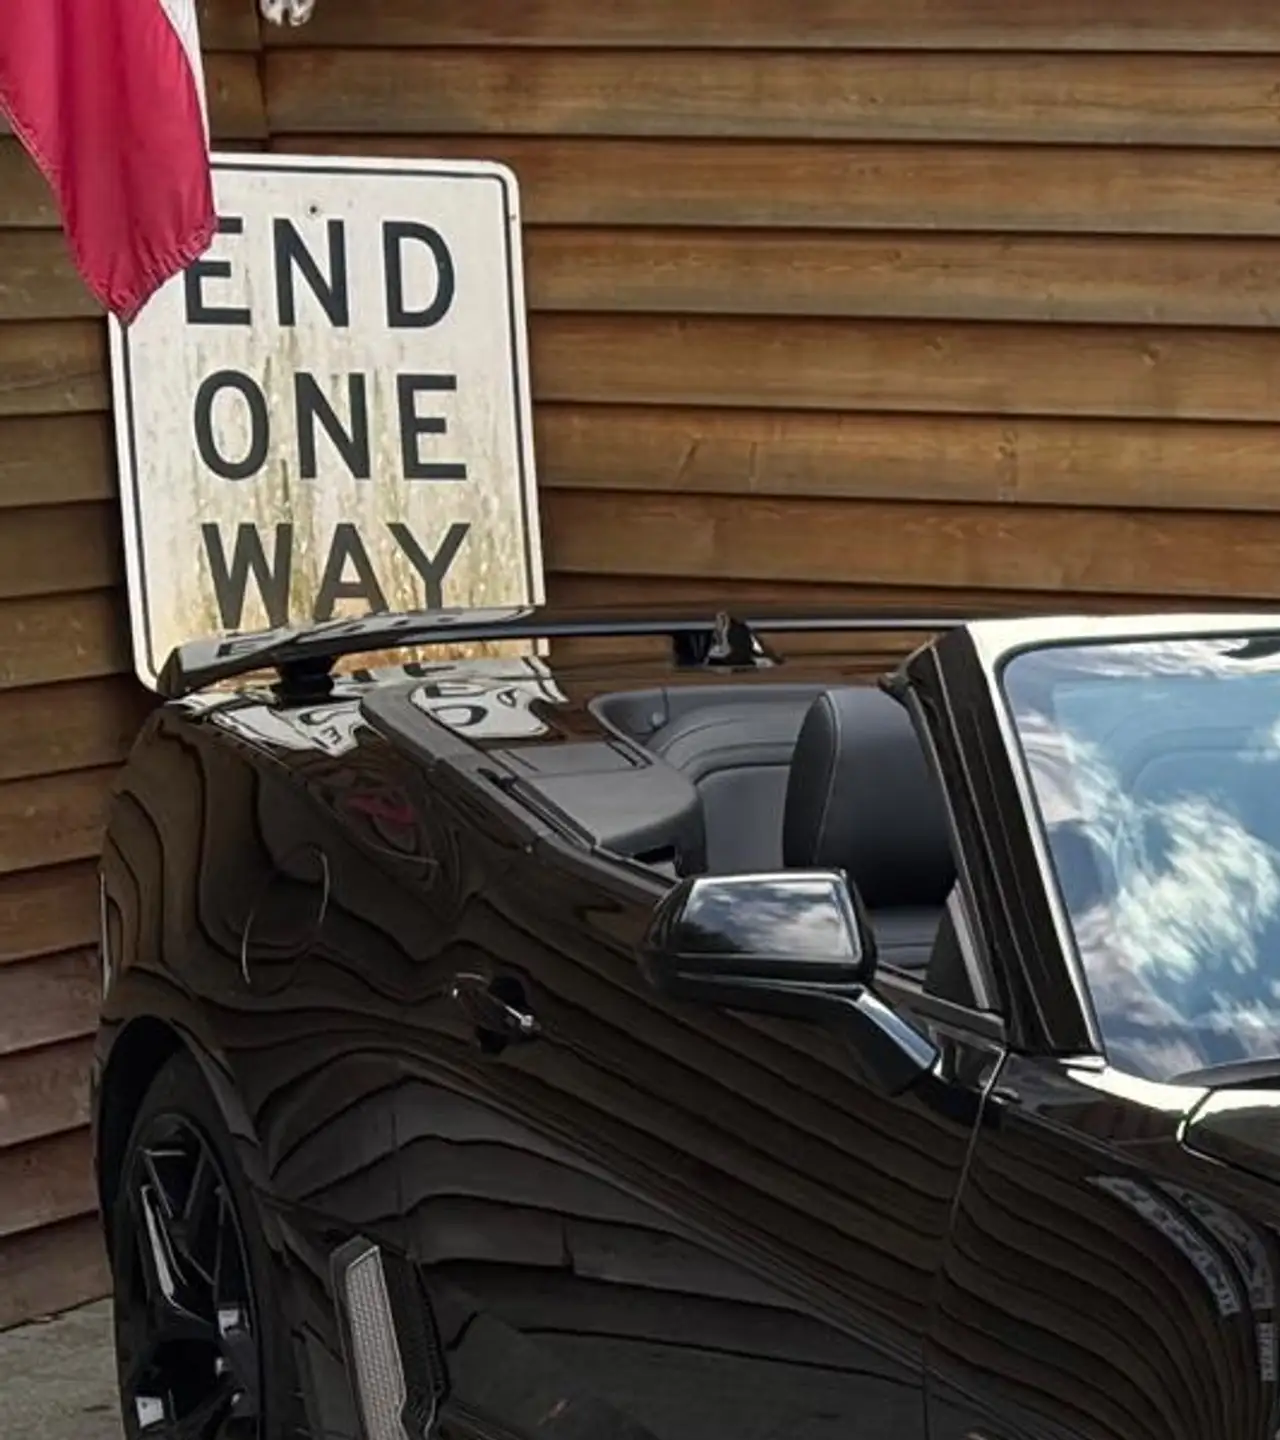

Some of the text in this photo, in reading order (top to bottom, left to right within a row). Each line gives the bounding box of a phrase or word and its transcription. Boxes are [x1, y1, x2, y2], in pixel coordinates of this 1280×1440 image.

[183, 217, 456, 328] END
[193, 369, 467, 481] ONE
[201, 522, 471, 630] WAY
